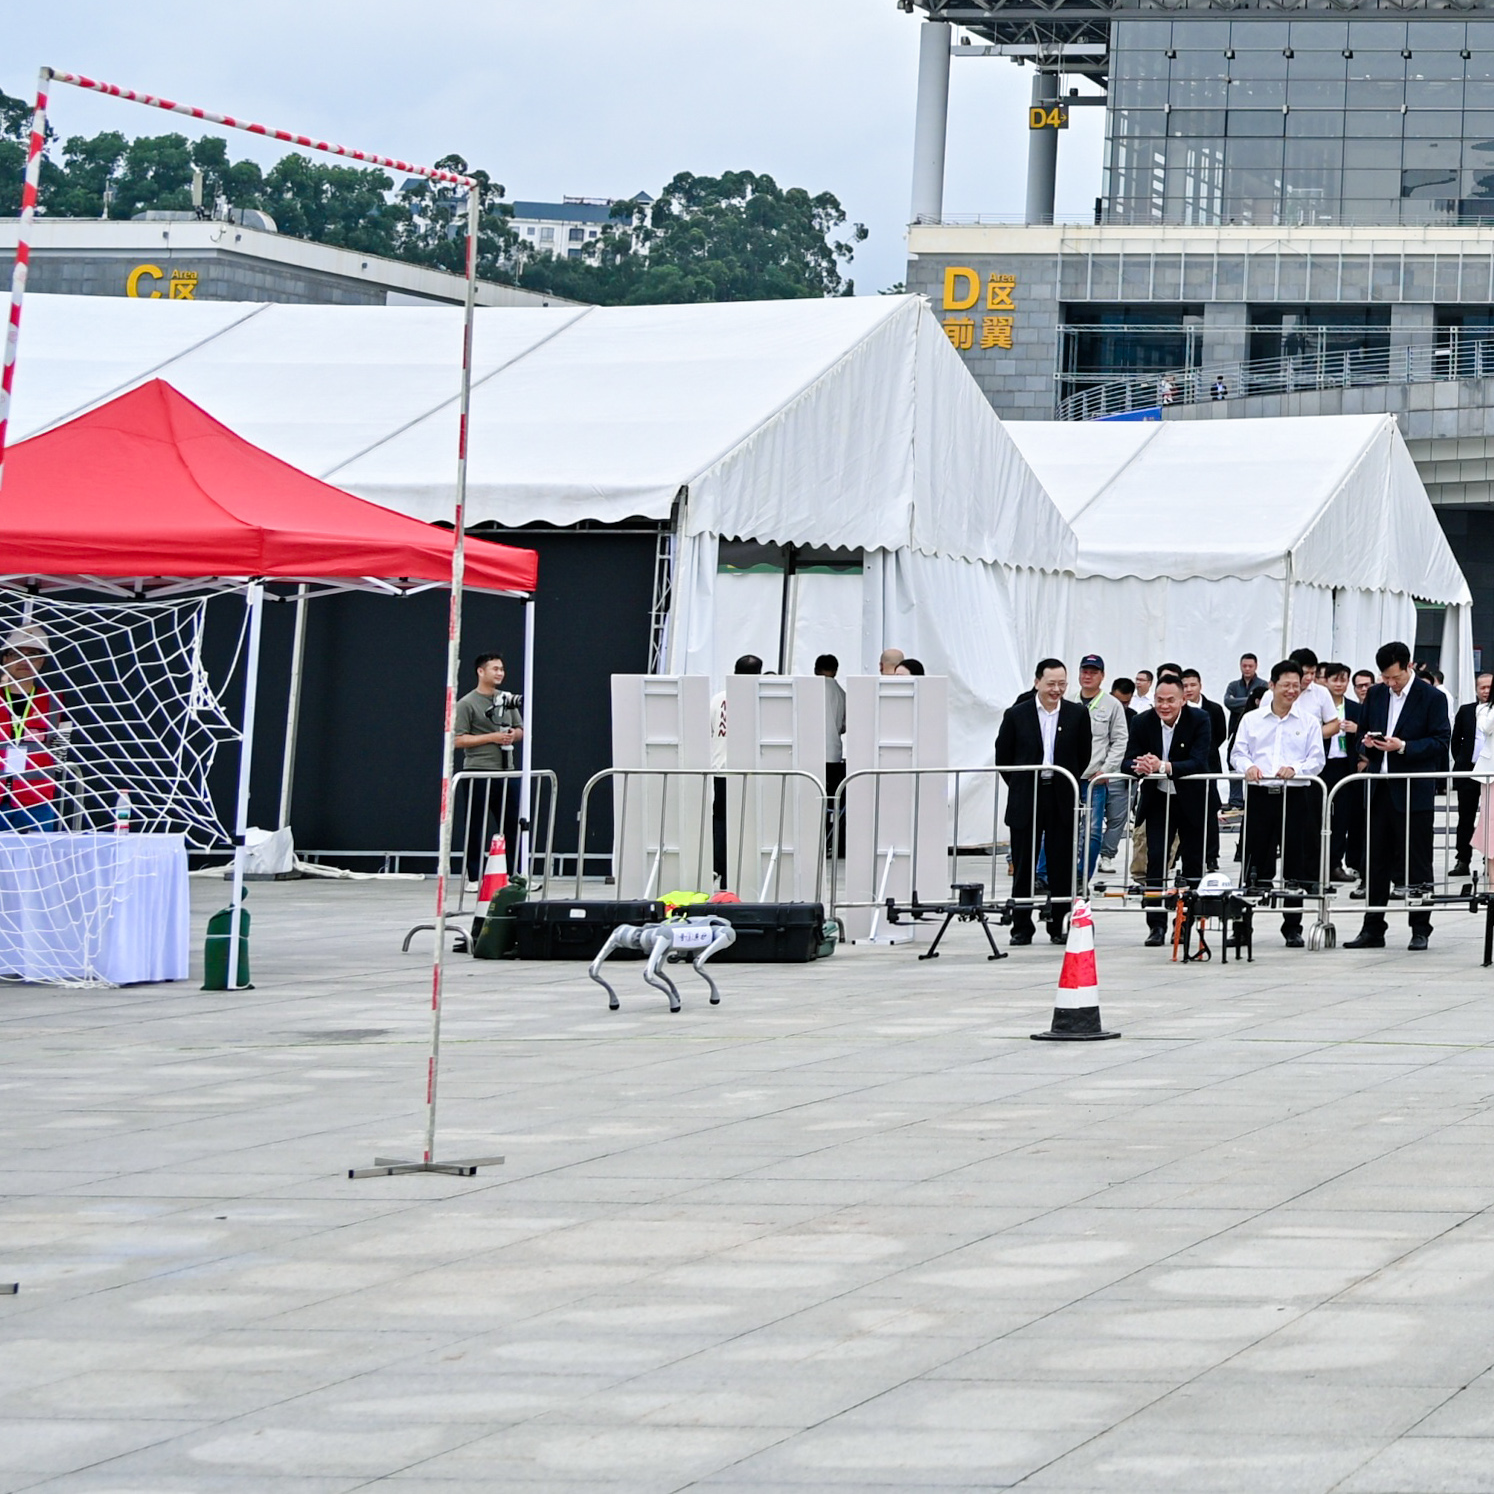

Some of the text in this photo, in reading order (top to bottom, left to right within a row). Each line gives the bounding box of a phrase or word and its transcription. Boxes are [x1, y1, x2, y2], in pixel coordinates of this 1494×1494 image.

[1030, 108, 1061, 128] D4
[172, 269, 198, 279] Area
[989, 273, 1015, 282] Area
[943, 317, 1014, 350] 前翼
